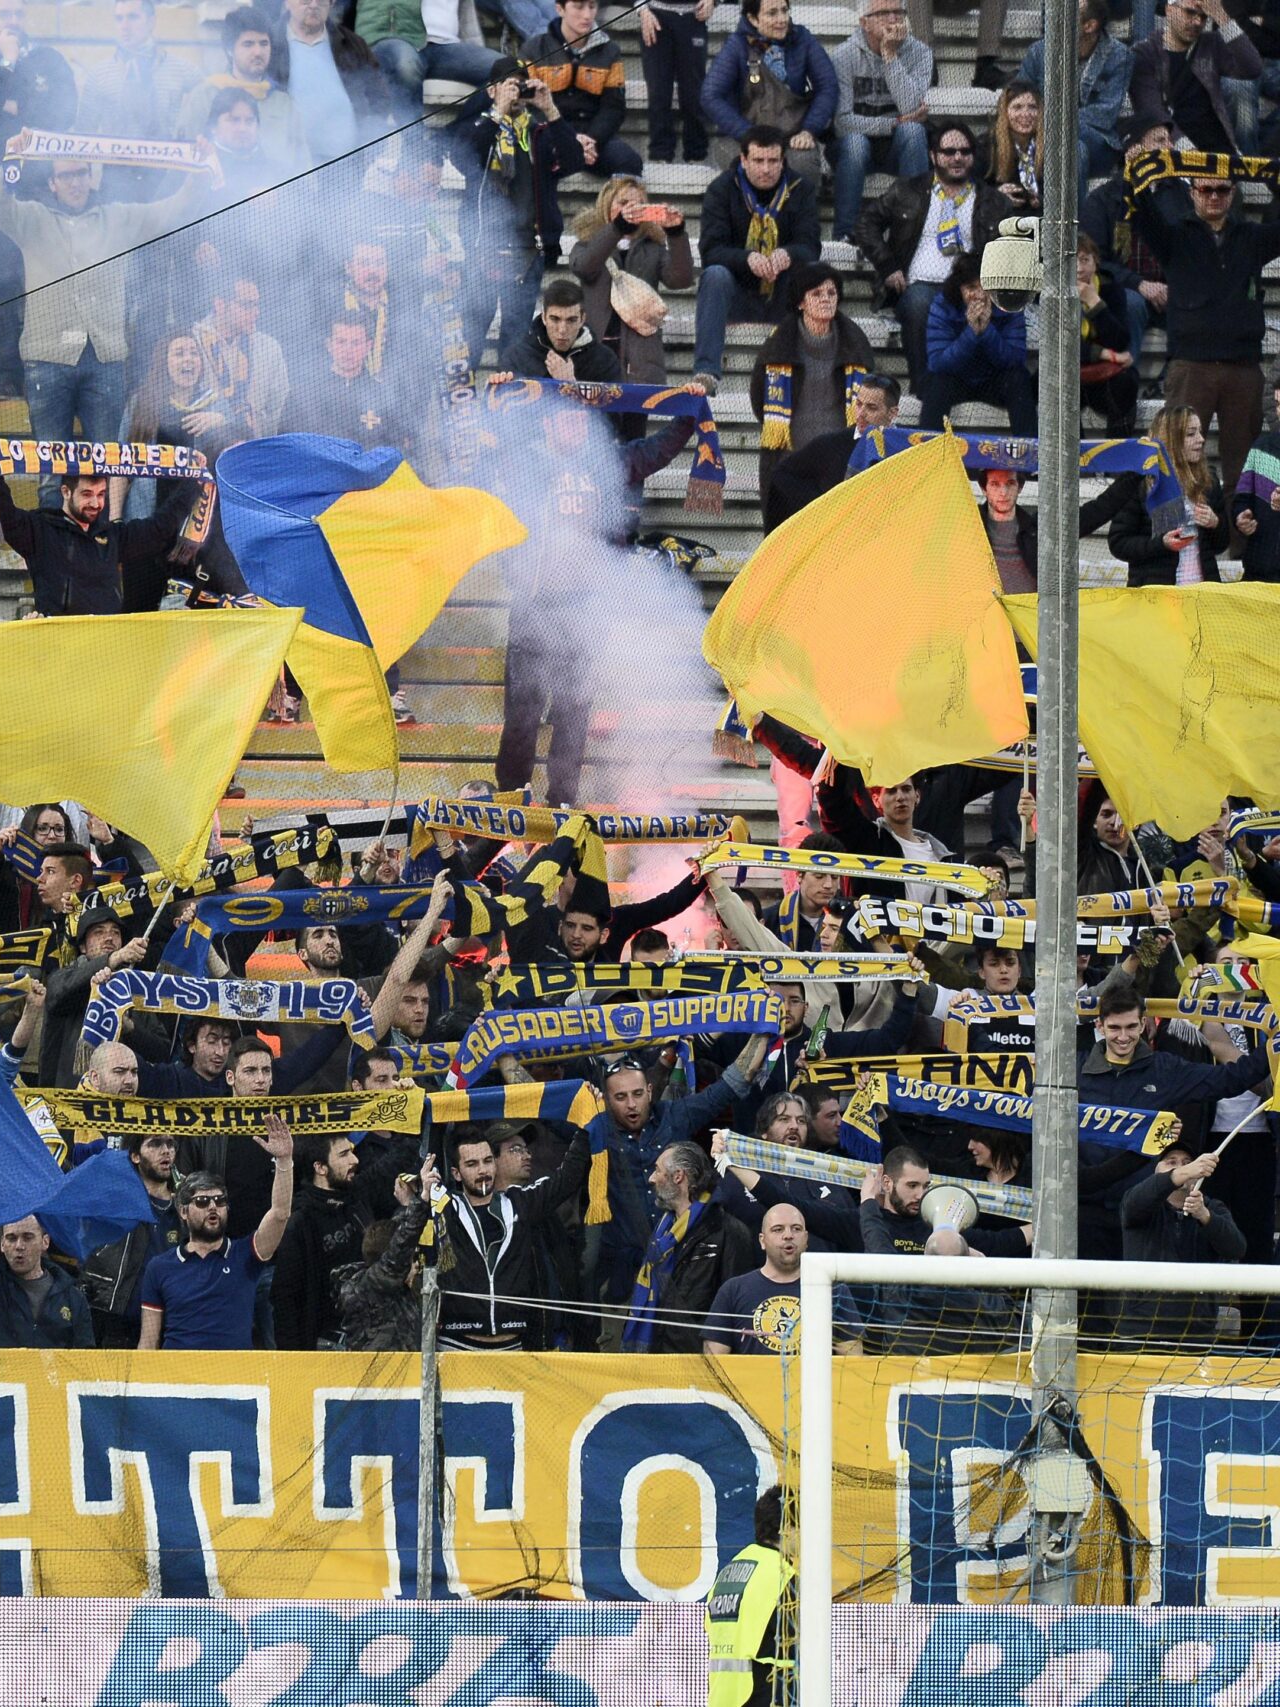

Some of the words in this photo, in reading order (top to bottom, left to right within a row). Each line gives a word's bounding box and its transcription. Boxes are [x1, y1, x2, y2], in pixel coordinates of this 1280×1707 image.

[35, 136, 104, 154] FORZA
[110, 143, 184, 158] PARMA
[37, 441, 106, 463] GRIDO
[95, 464, 138, 475] PARMA
[141, 465, 165, 476] A.C.
[169, 467, 201, 479] CLUB
[763, 849, 928, 876] BOYS
[724, 957, 861, 975] OYS
[460, 1004, 601, 1074] CRUSADER
[654, 992, 784, 1028] SUPPORTE
[82, 1100, 352, 1125] GLADIATORS
[895, 1076, 970, 1111] Boys
[1079, 1105, 1146, 1136] 1977
[445, 1322, 473, 1330] adidas
